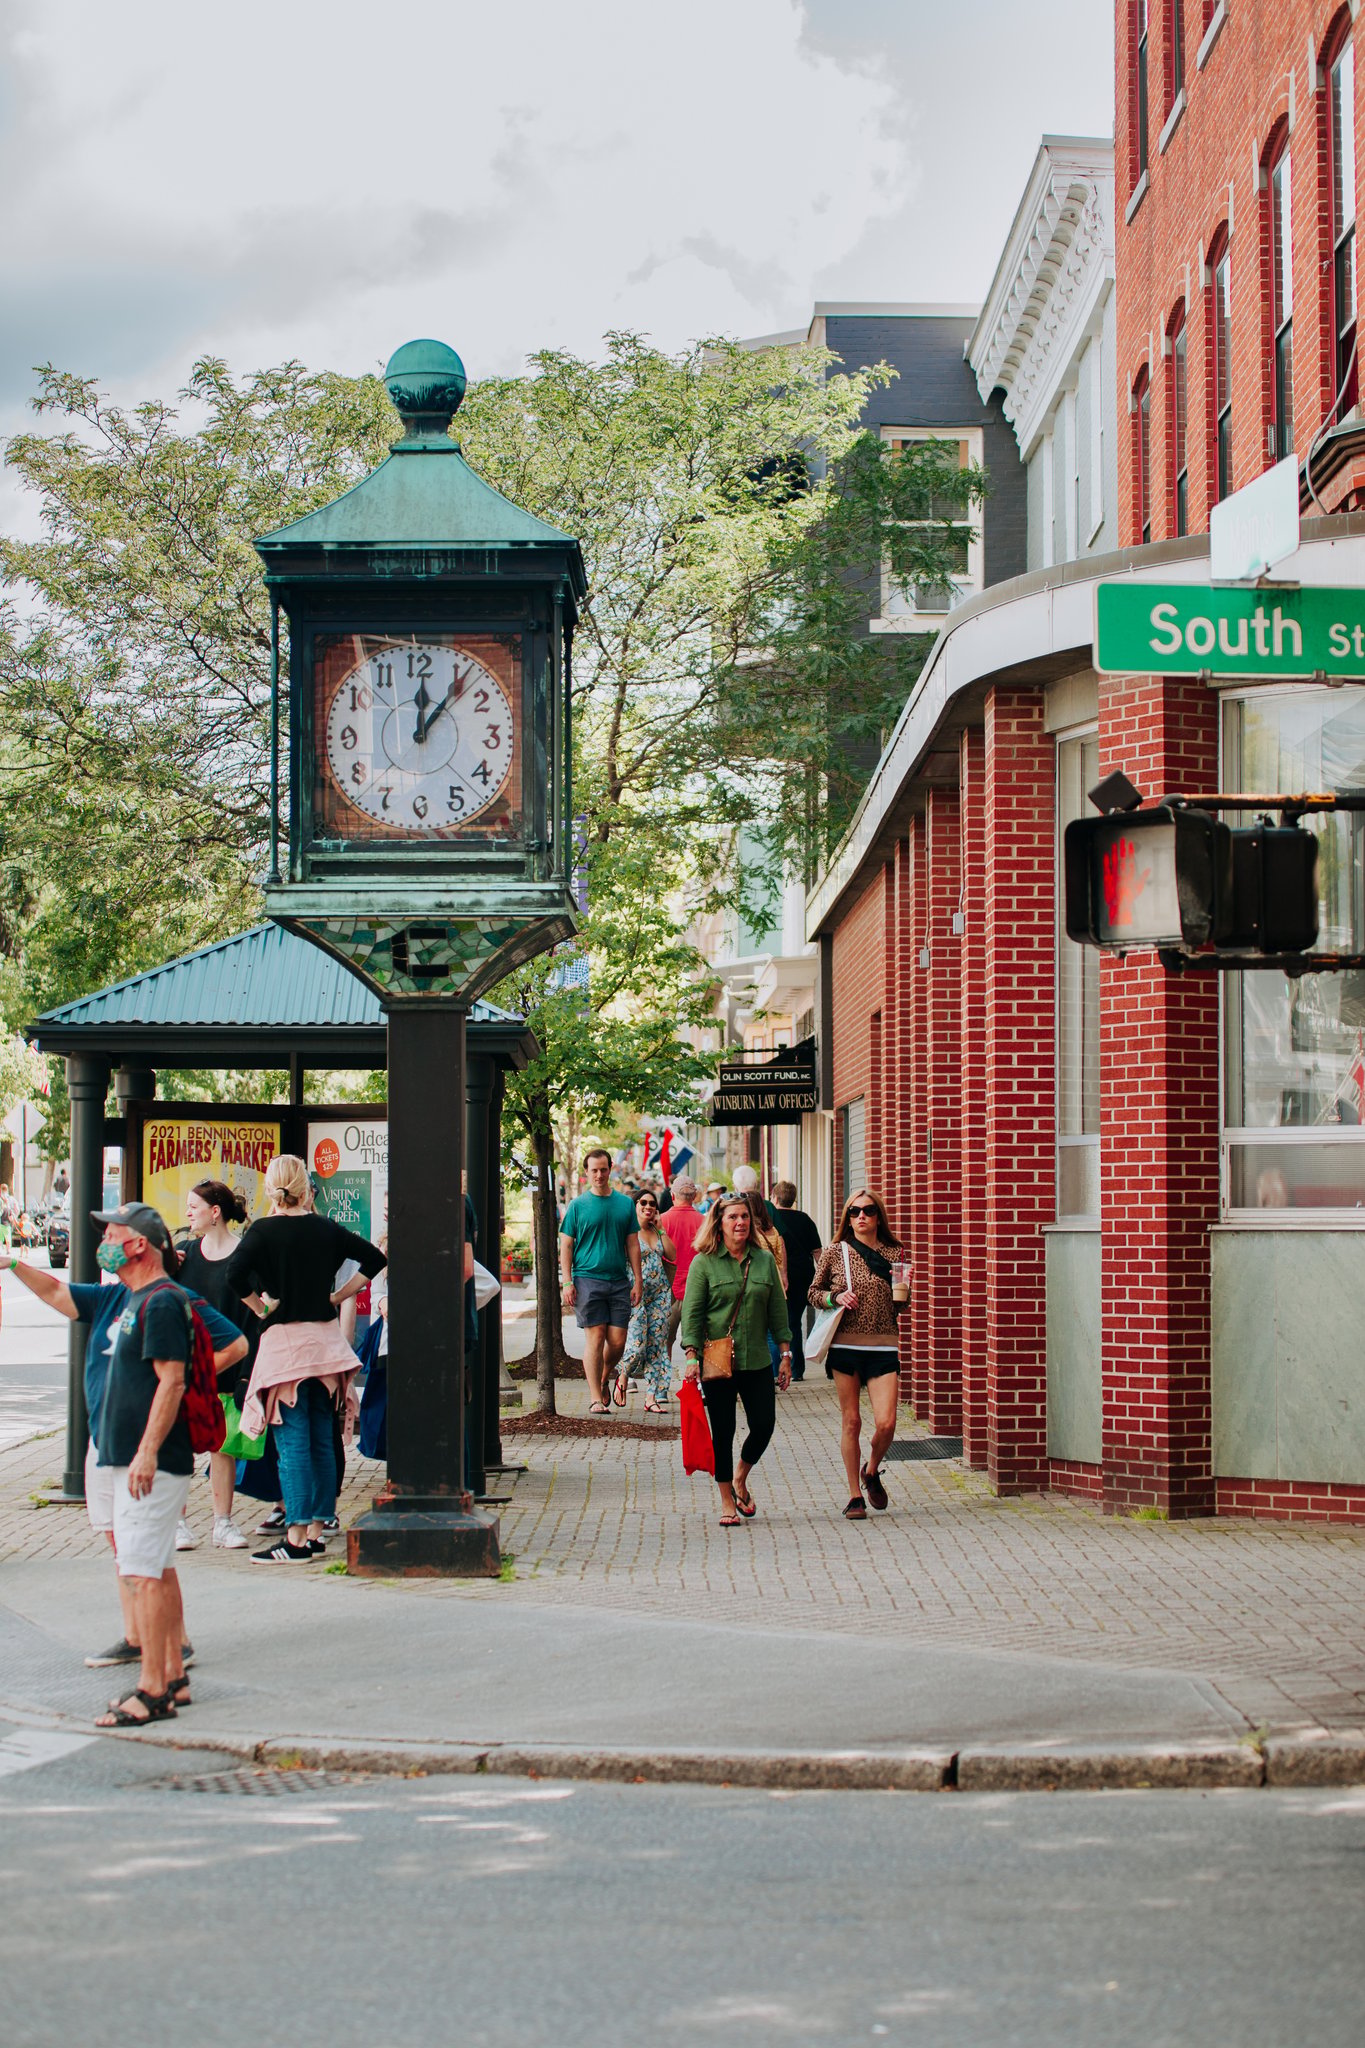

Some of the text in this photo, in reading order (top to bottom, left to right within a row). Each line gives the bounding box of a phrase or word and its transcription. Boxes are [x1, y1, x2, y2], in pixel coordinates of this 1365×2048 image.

[1149, 603, 1365, 658] South St
[376, 662, 393, 689] 11
[406, 652, 434, 679] 12
[350, 685, 373, 712] 10
[473, 688, 490, 713] 2
[340, 725, 358, 750] 9
[482, 723, 501, 750] 3
[351, 761, 366, 786] 8
[470, 759, 493, 786] 4
[377, 786, 394, 812] 7
[412, 795, 429, 820] 6
[446, 785, 465, 812] 5
[722, 1073, 742, 1081] OLIN
[744, 1072, 772, 1080] SCOTT
[774, 1071, 800, 1080] FUND,
[713, 1092, 815, 1110] WINBURN LAW OFFICES
[150, 1125, 274, 1141] 2021 BENNINGTON
[149, 1139, 275, 1175] FARMERS' MARKET
[316, 1153, 339, 1163] TICKETS
[323, 1163, 333, 1171] $25
[322, 1186, 360, 1202] VISITING
[338, 1199, 353, 1211] MR.
[327, 1207, 360, 1222] GREEN
